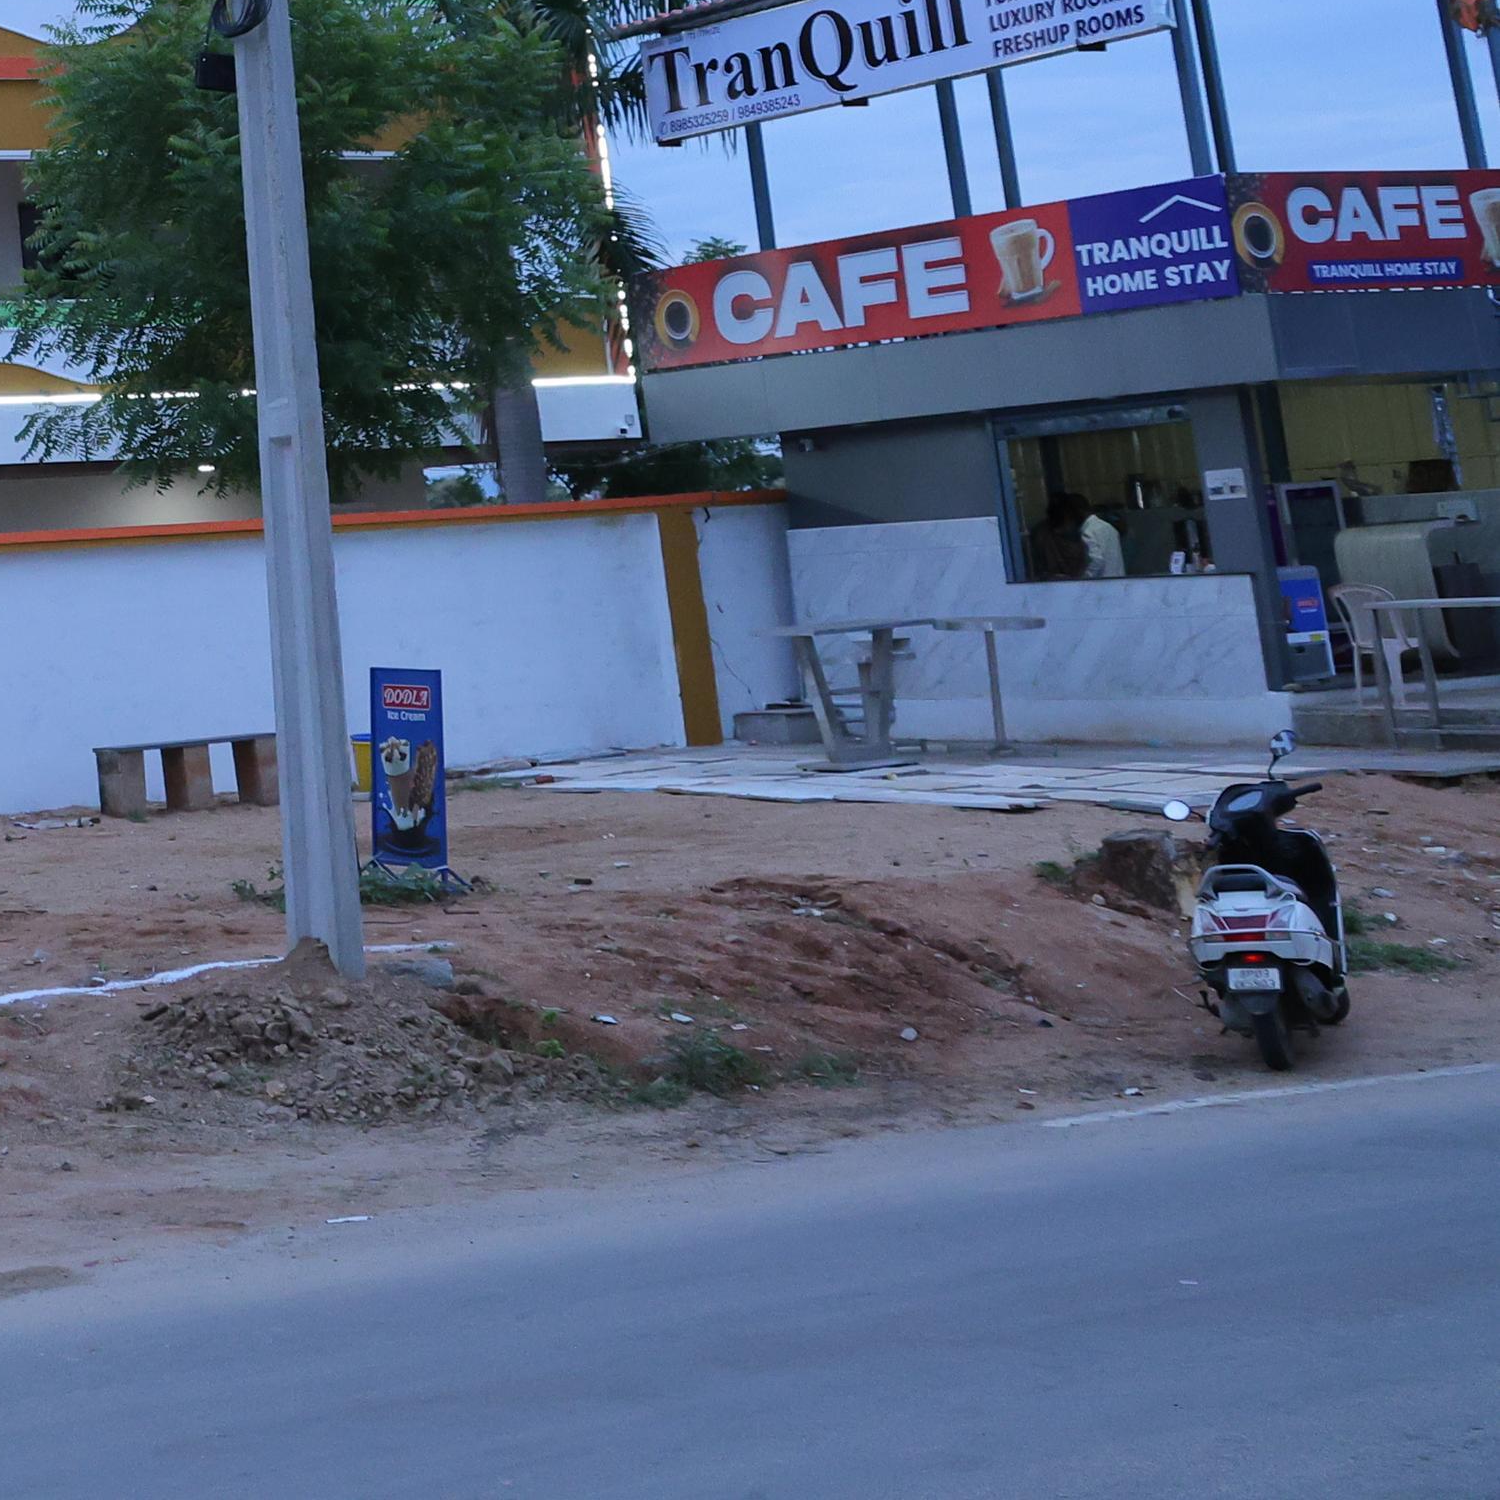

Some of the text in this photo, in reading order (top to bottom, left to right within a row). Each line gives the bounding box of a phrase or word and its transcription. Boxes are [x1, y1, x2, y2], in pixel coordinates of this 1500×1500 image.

[988, 0, 1056, 33] LUXURY
[993, 5, 1146, 58] FRESHUP ROOMS
[1286, 185, 1468, 244] CAFE
[1075, 225, 1229, 268] TRANQUILL
[712, 236, 971, 345] CAFE
[1086, 259, 1232, 298] HOME STAY
[1312, 261, 1457, 280] TRANQUILL HOME STAY
[384, 688, 429, 706] DODLA
